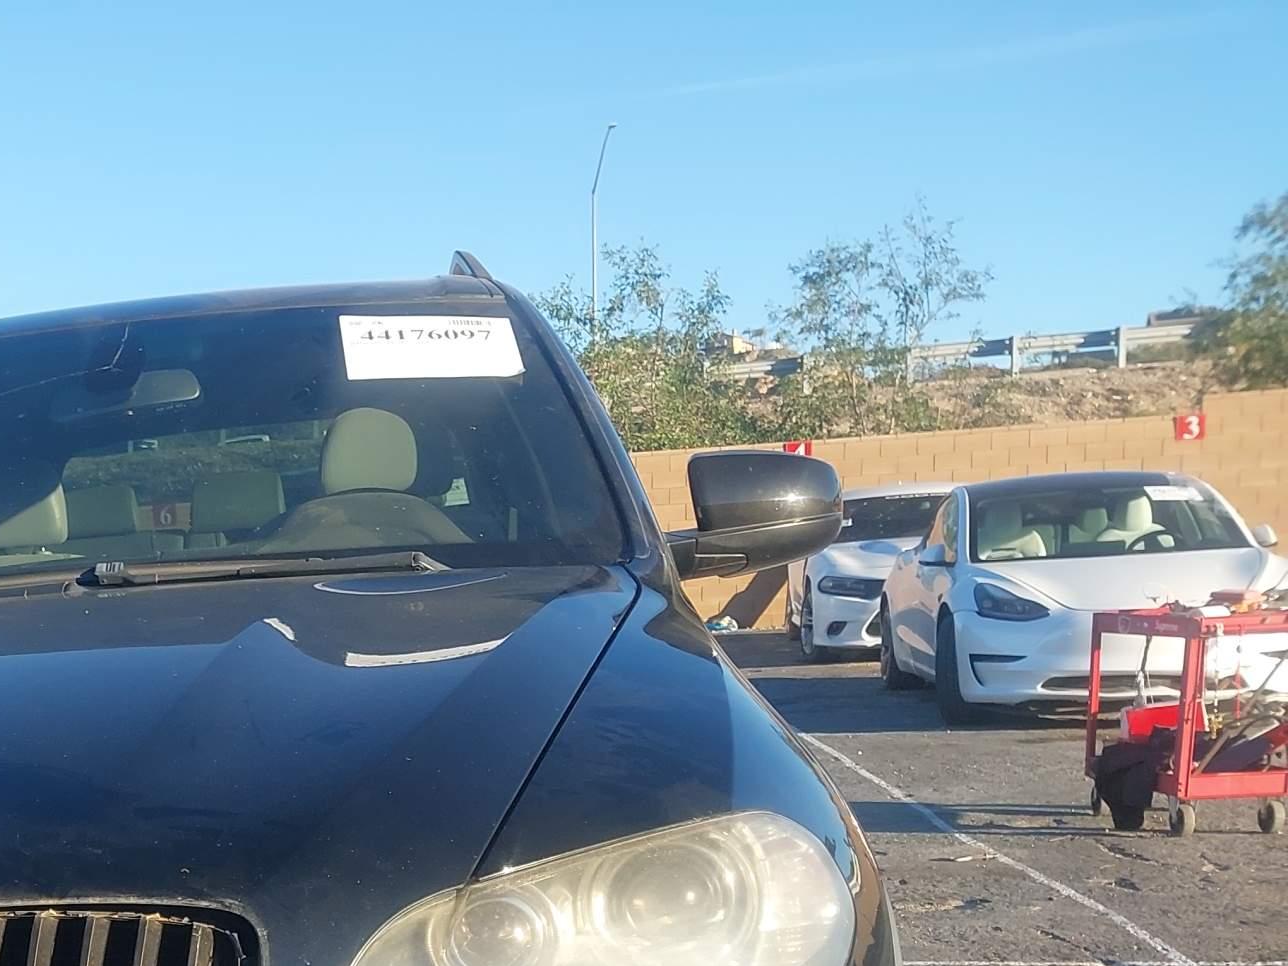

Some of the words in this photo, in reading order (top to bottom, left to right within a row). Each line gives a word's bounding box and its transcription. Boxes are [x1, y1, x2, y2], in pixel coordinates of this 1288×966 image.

[360, 329, 490, 340] 44176097
[1182, 416, 1200, 440] 3
[160, 505, 172, 525] 6
